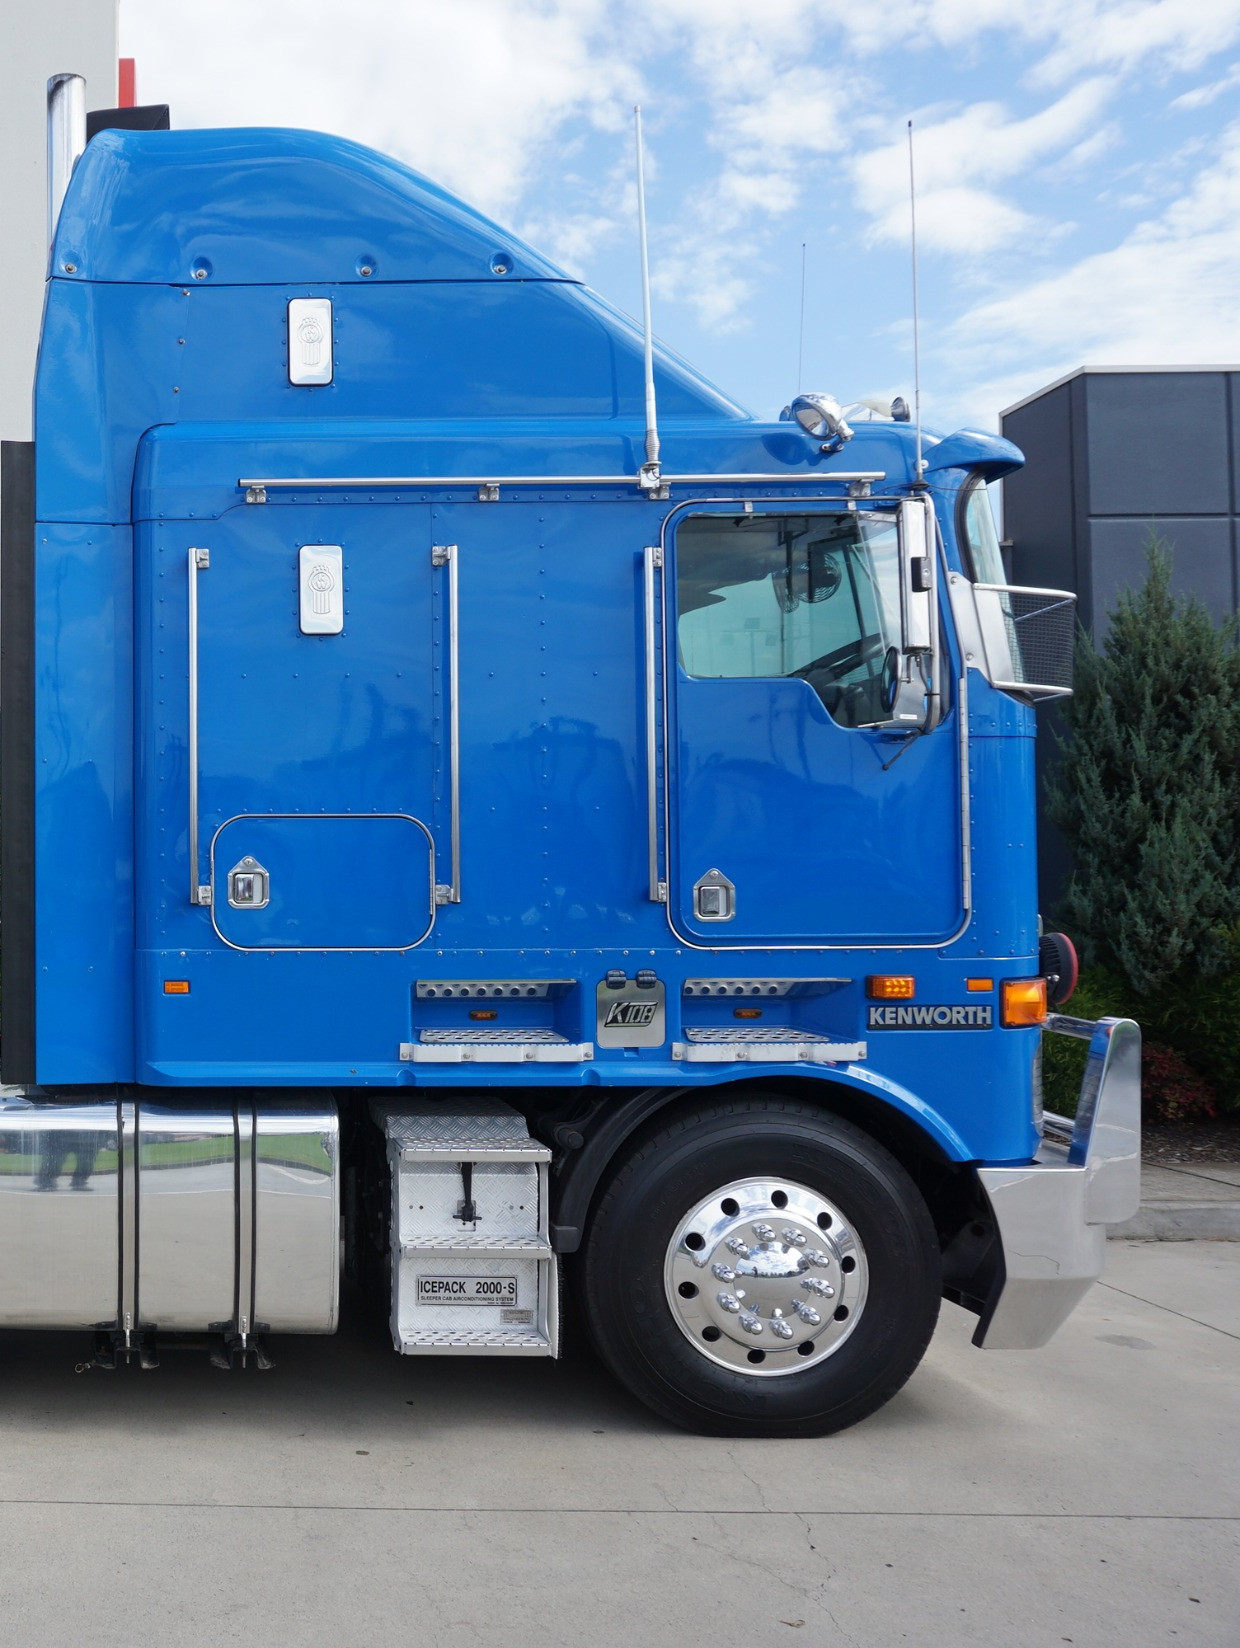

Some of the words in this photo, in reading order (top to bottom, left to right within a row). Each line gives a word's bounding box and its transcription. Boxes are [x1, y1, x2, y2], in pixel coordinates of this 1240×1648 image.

[869, 1006, 992, 1025] KENWORTH
[420, 1281, 467, 1294] ICEPACK
[475, 1282, 515, 1294] 2000-S
